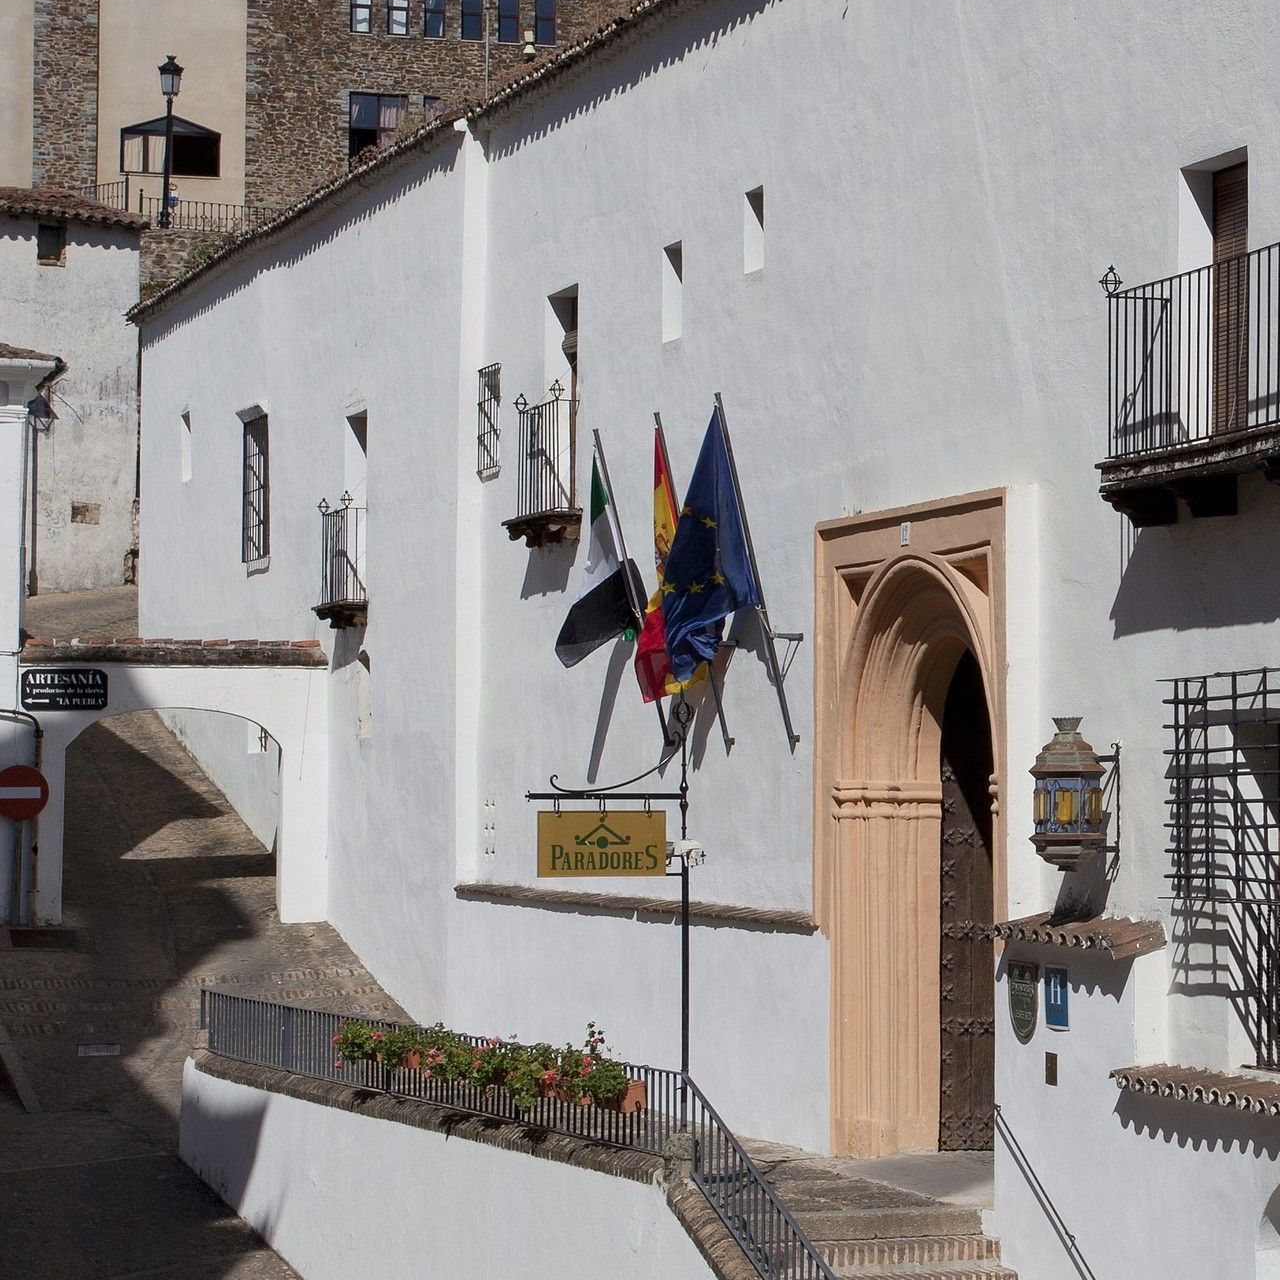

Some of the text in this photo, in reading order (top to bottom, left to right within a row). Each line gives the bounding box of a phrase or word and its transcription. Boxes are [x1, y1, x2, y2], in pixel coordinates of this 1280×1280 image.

[26, 671, 102, 684] ARTESANÍA
[32, 687, 65, 695] productos
[550, 844, 658, 871] PARADORES
